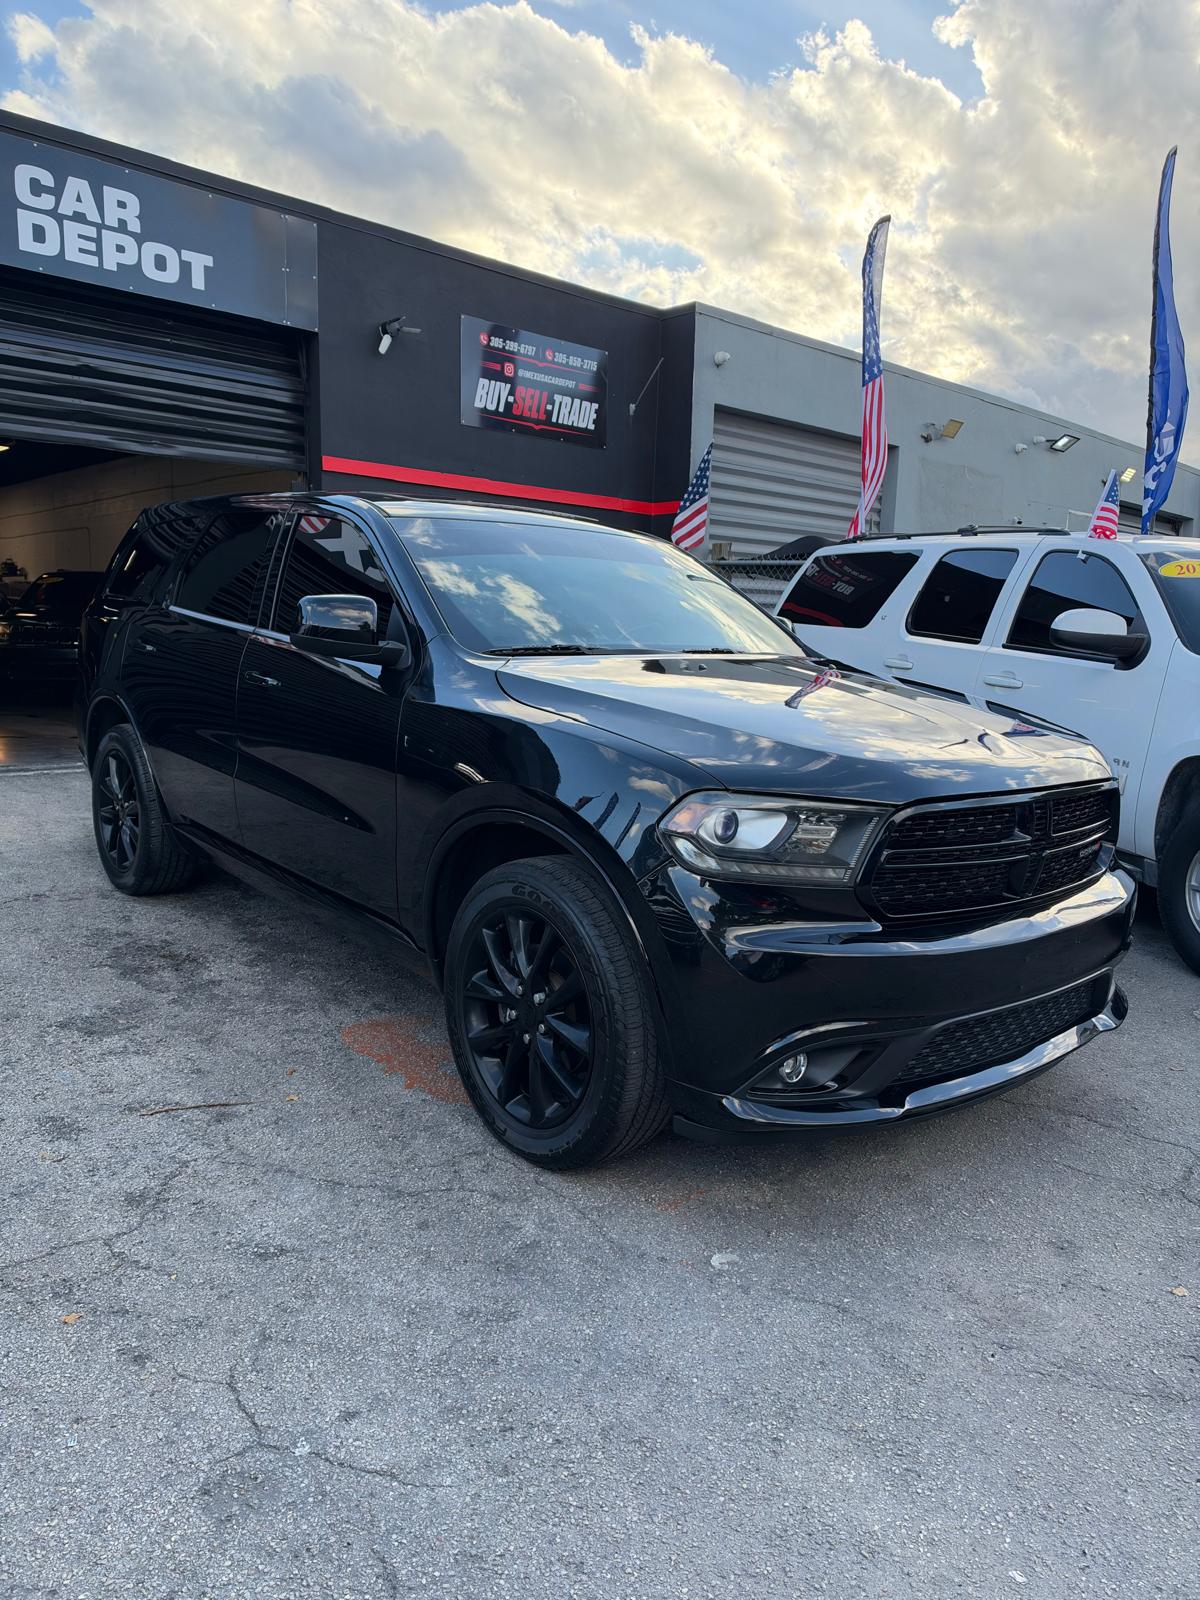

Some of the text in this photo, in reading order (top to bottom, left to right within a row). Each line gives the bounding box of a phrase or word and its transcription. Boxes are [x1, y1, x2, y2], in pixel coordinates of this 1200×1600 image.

[14, 164, 141, 233] CAR
[16, 208, 214, 291] DEPOT
[474, 377, 599, 430] BUY-SELL-TRADE
